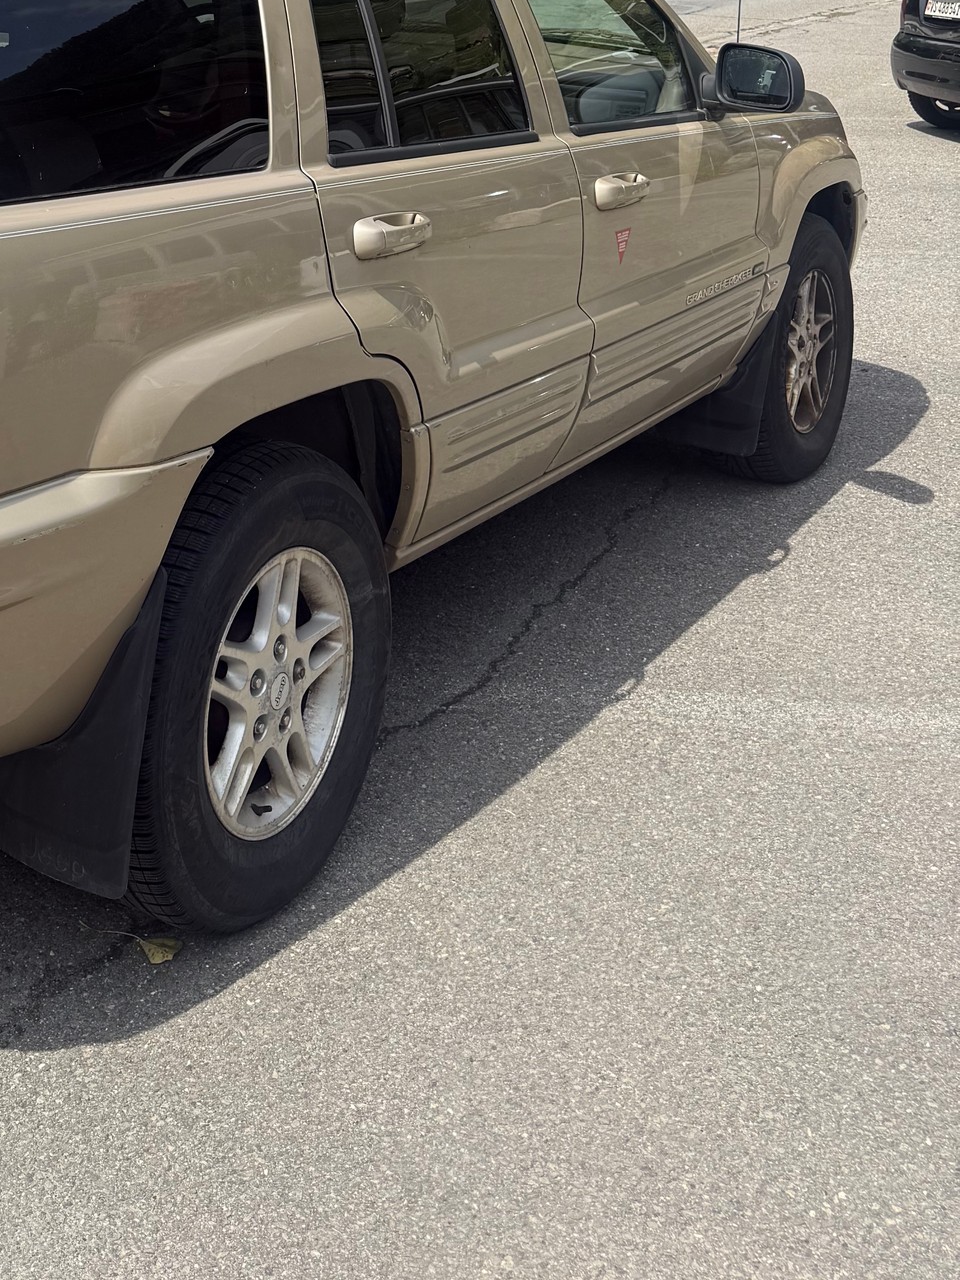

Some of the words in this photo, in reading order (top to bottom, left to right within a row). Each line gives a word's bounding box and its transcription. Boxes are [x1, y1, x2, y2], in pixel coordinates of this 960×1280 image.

[686, 283, 714, 305] GRAND
[714, 269, 752, 295] CHEROKEE
[275, 675, 288, 707] Jeep
